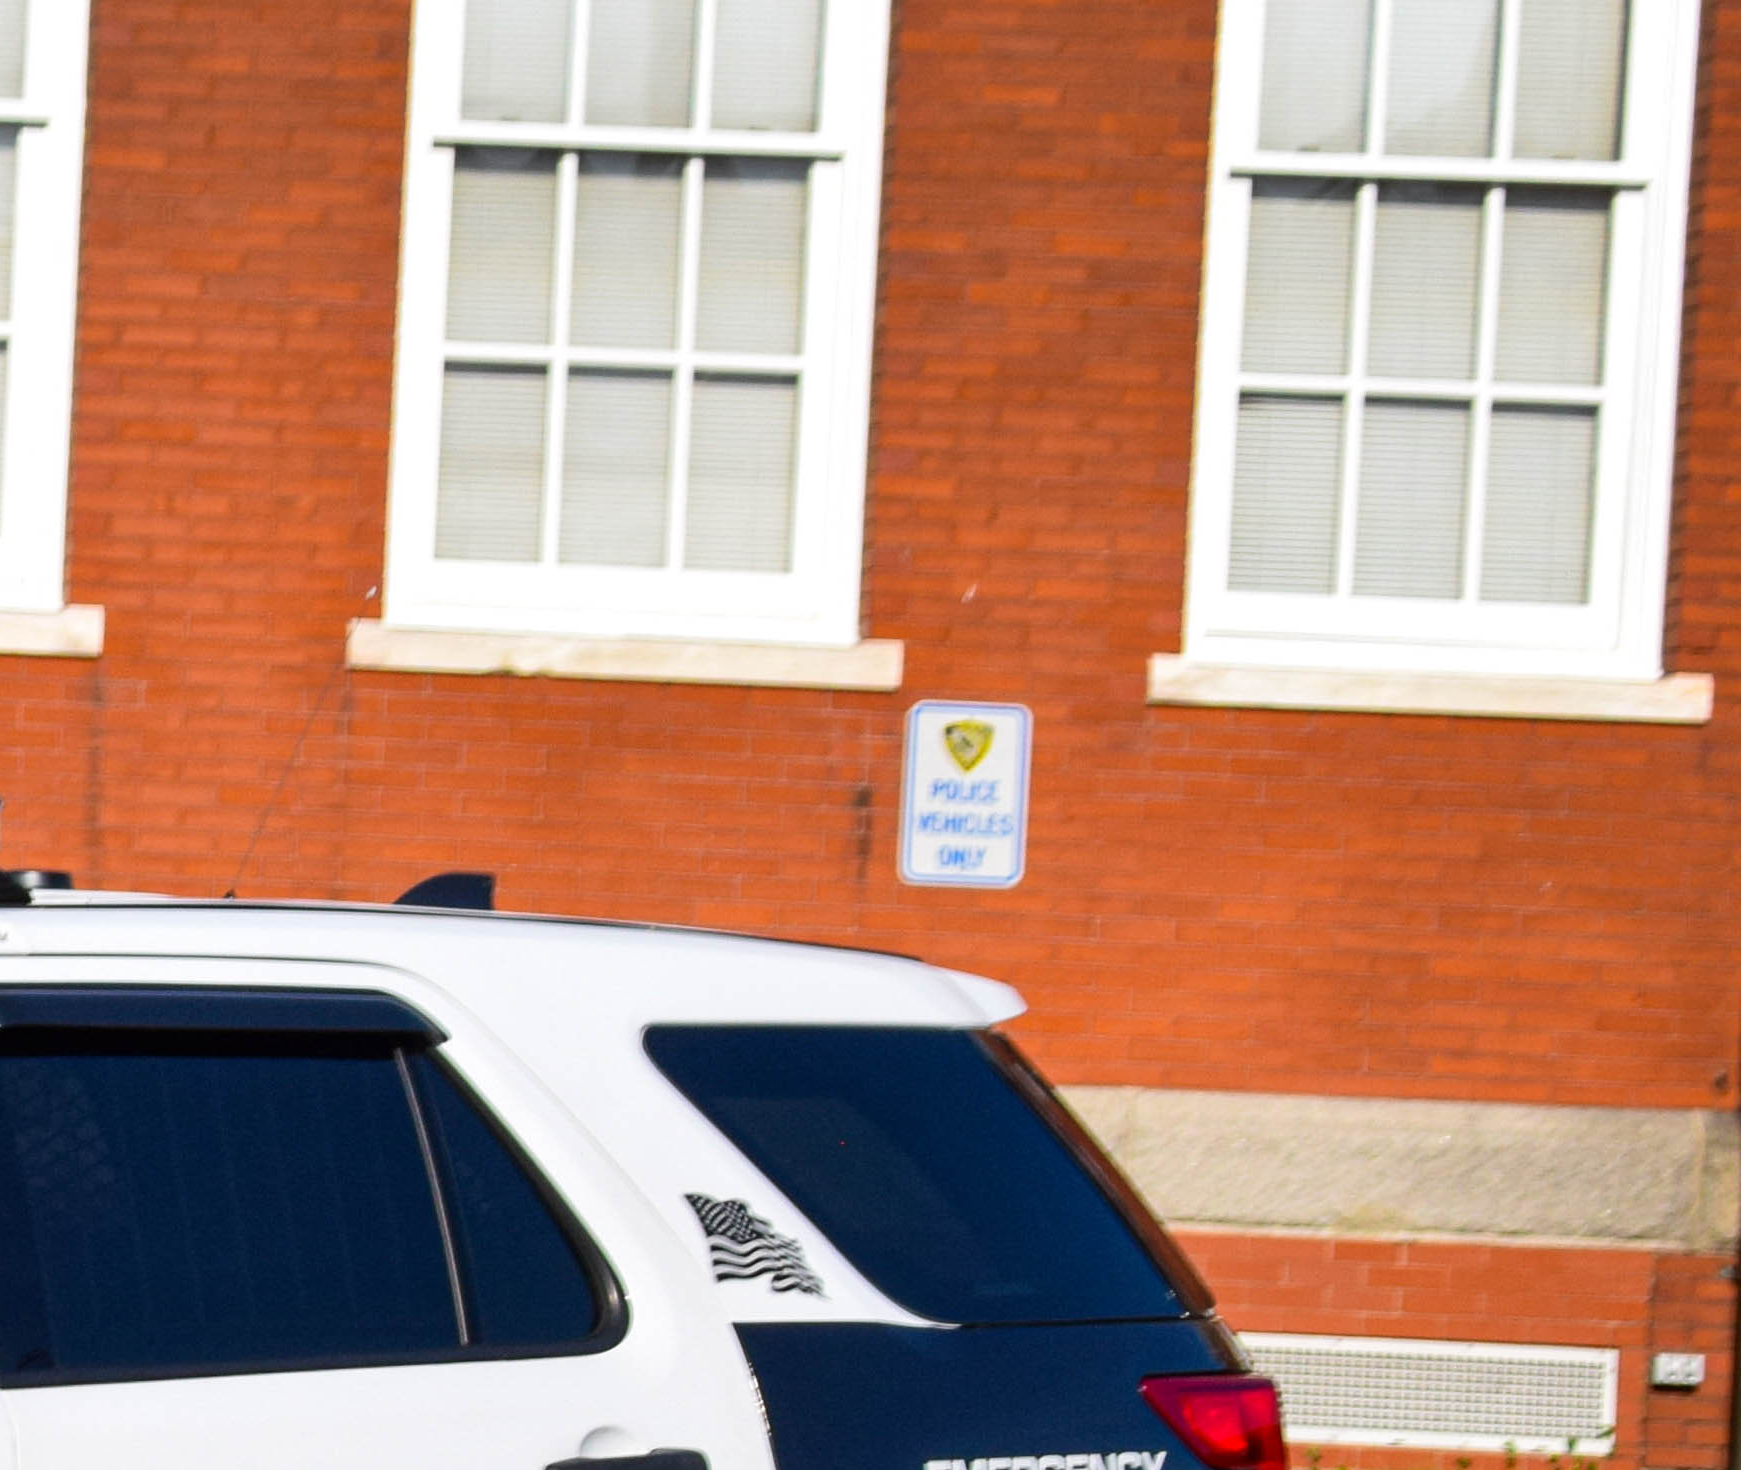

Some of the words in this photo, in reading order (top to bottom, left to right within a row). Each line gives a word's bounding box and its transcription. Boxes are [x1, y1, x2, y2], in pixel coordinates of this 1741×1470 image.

[929, 777, 1000, 804] POLICE
[918, 811, 1015, 837] VEHICLES
[937, 845, 987, 871] ONLY
